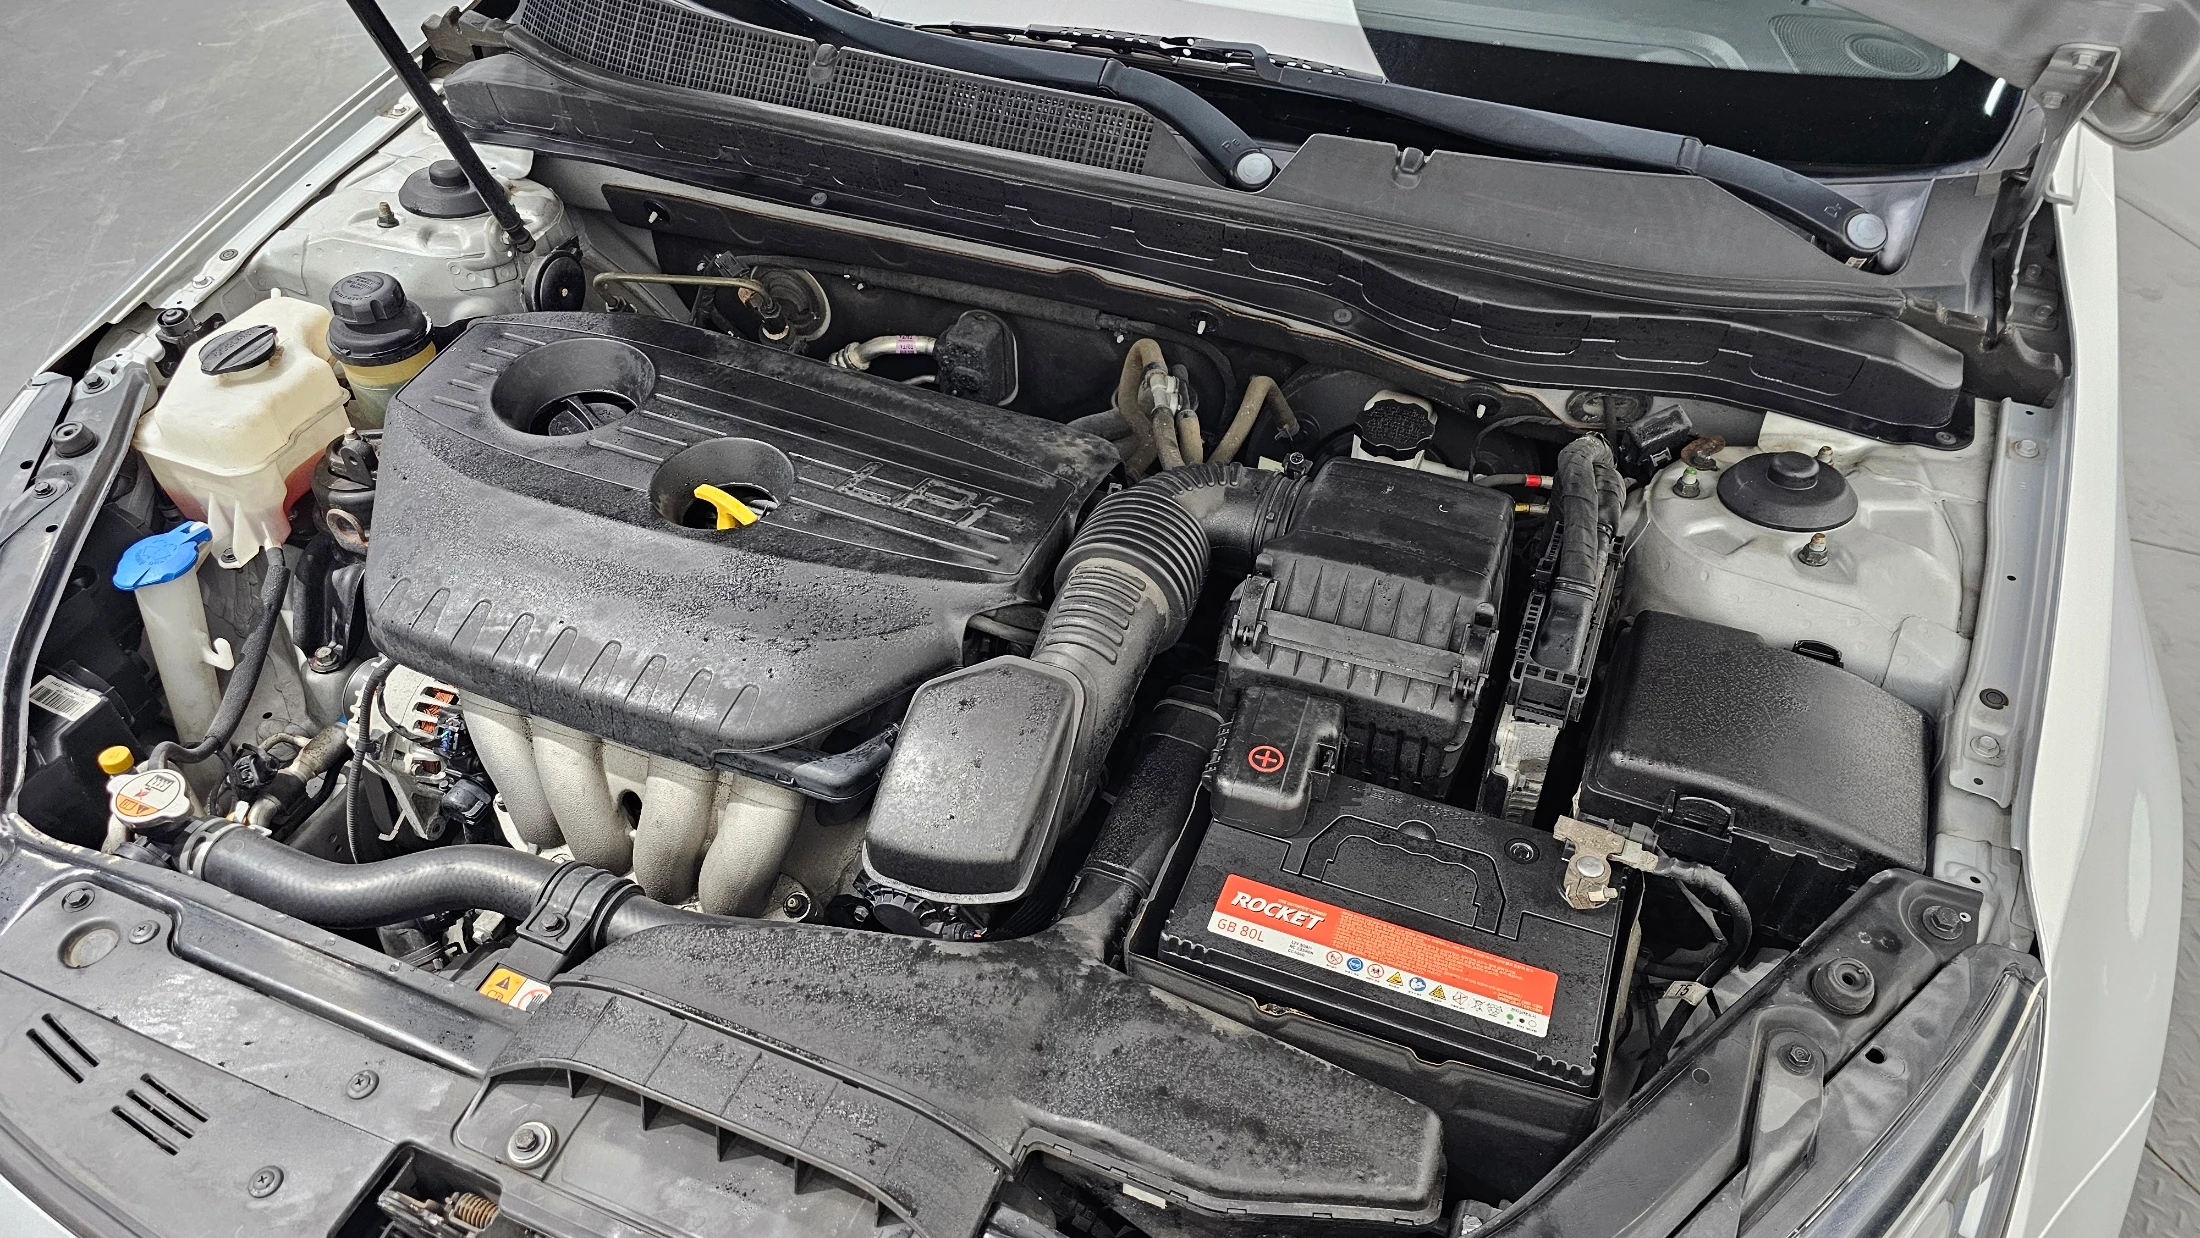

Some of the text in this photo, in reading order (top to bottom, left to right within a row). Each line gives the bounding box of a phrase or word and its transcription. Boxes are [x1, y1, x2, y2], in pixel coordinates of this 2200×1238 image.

[1231, 891, 1325, 930] ROCKET
[1217, 918, 1264, 943] GB 80L
[1674, 984, 1692, 996] T5
